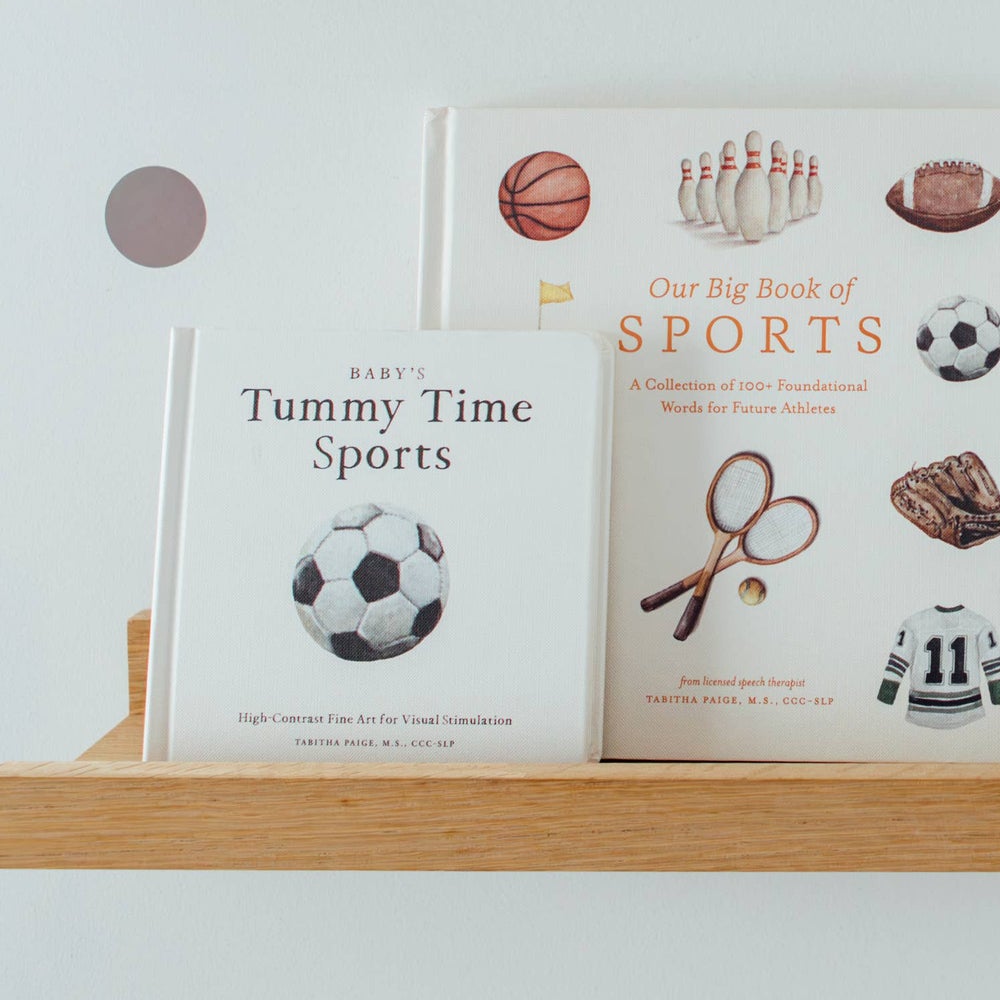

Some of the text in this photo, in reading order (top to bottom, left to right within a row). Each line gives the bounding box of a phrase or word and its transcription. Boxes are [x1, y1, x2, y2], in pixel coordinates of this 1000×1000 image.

[650, 277, 858, 305] Our Big Book of
[618, 315, 882, 354] SPORTS
[350, 367, 427, 380] BABY'S
[629, 379, 641, 391] A
[645, 378, 716, 391] Collection
[720, 378, 736, 391] of
[777, 379, 868, 392] Foundational
[240, 387, 533, 435] Tummy Time
[661, 401, 836, 414] Words for Future Athletes
[312, 435, 452, 480] Sports
[924, 635, 969, 685] 11
[678, 675, 805, 690] from licensed speech therapist
[646, 695, 834, 706] TABITHA PAIGE, M.S., CCC-SLP
[238, 712, 512, 726] High-Contrast Fine Art for Visual Stimulation
[295, 738, 340, 747] TABITHA
[345, 739, 378, 748] PAIGE,
[411, 740, 455, 748] CCC-SLP
